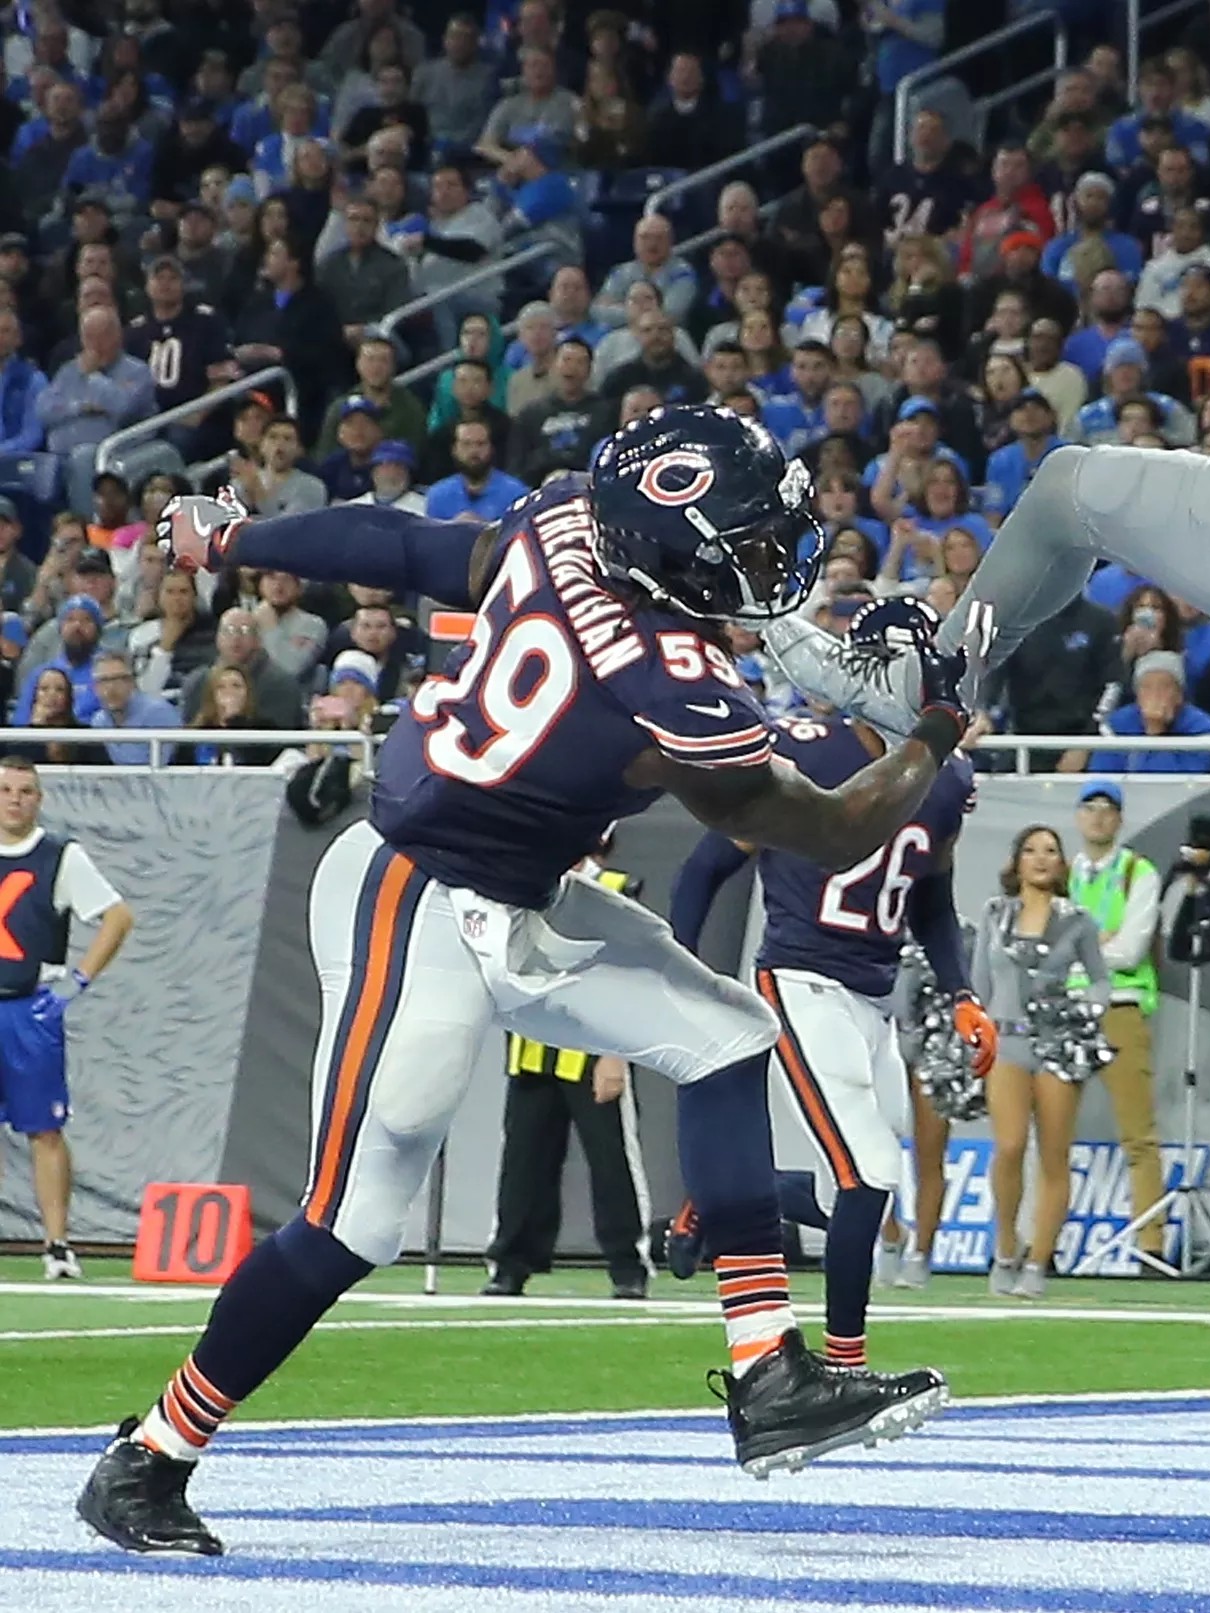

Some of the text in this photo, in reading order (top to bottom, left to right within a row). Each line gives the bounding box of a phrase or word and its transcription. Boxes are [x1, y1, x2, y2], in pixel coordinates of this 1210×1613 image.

[656, 632, 744, 689] 59
[819, 822, 931, 936] 26
[154, 1190, 231, 1275] 10
